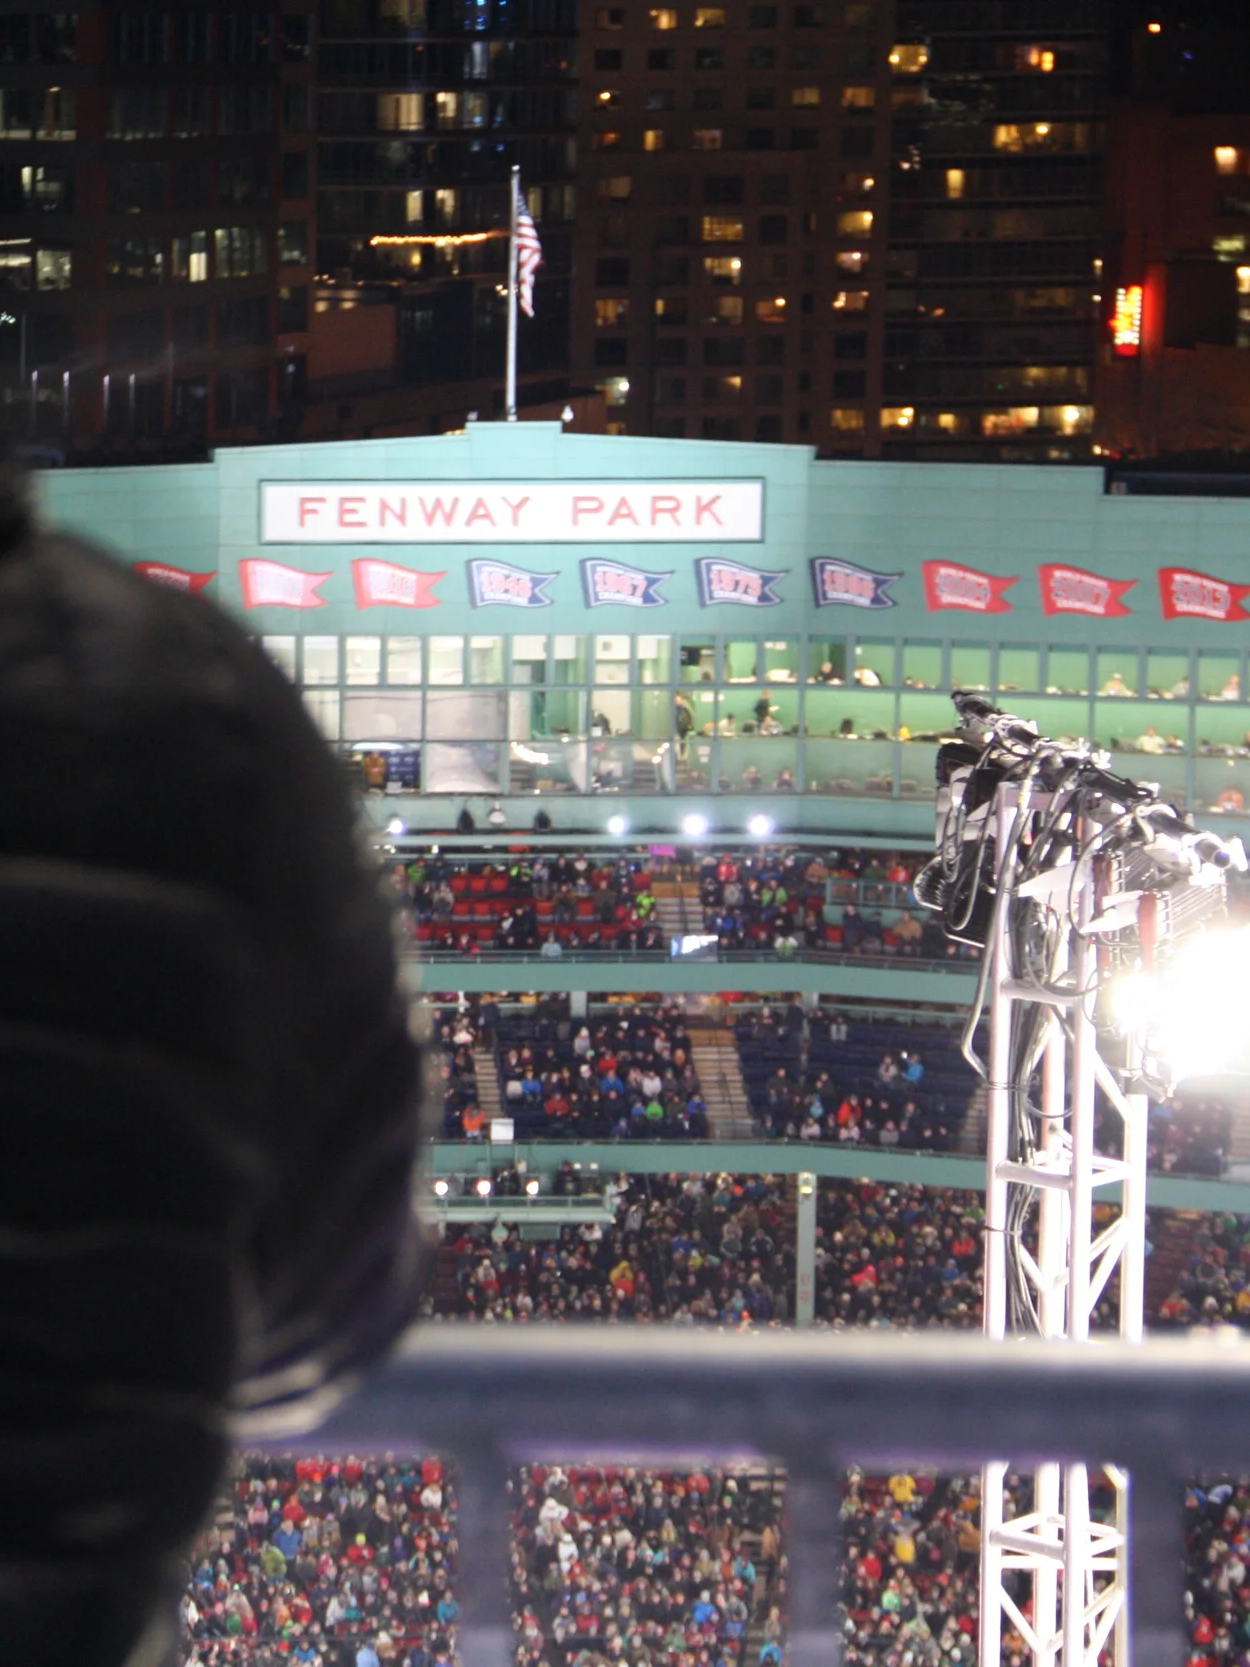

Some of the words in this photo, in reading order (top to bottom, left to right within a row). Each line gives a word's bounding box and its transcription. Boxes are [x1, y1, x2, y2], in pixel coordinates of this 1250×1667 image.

[298, 496, 530, 527] FENWAY
[571, 495, 724, 526] PARK
[710, 569, 762, 597] 1975
[1171, 581, 1231, 611] 2013
